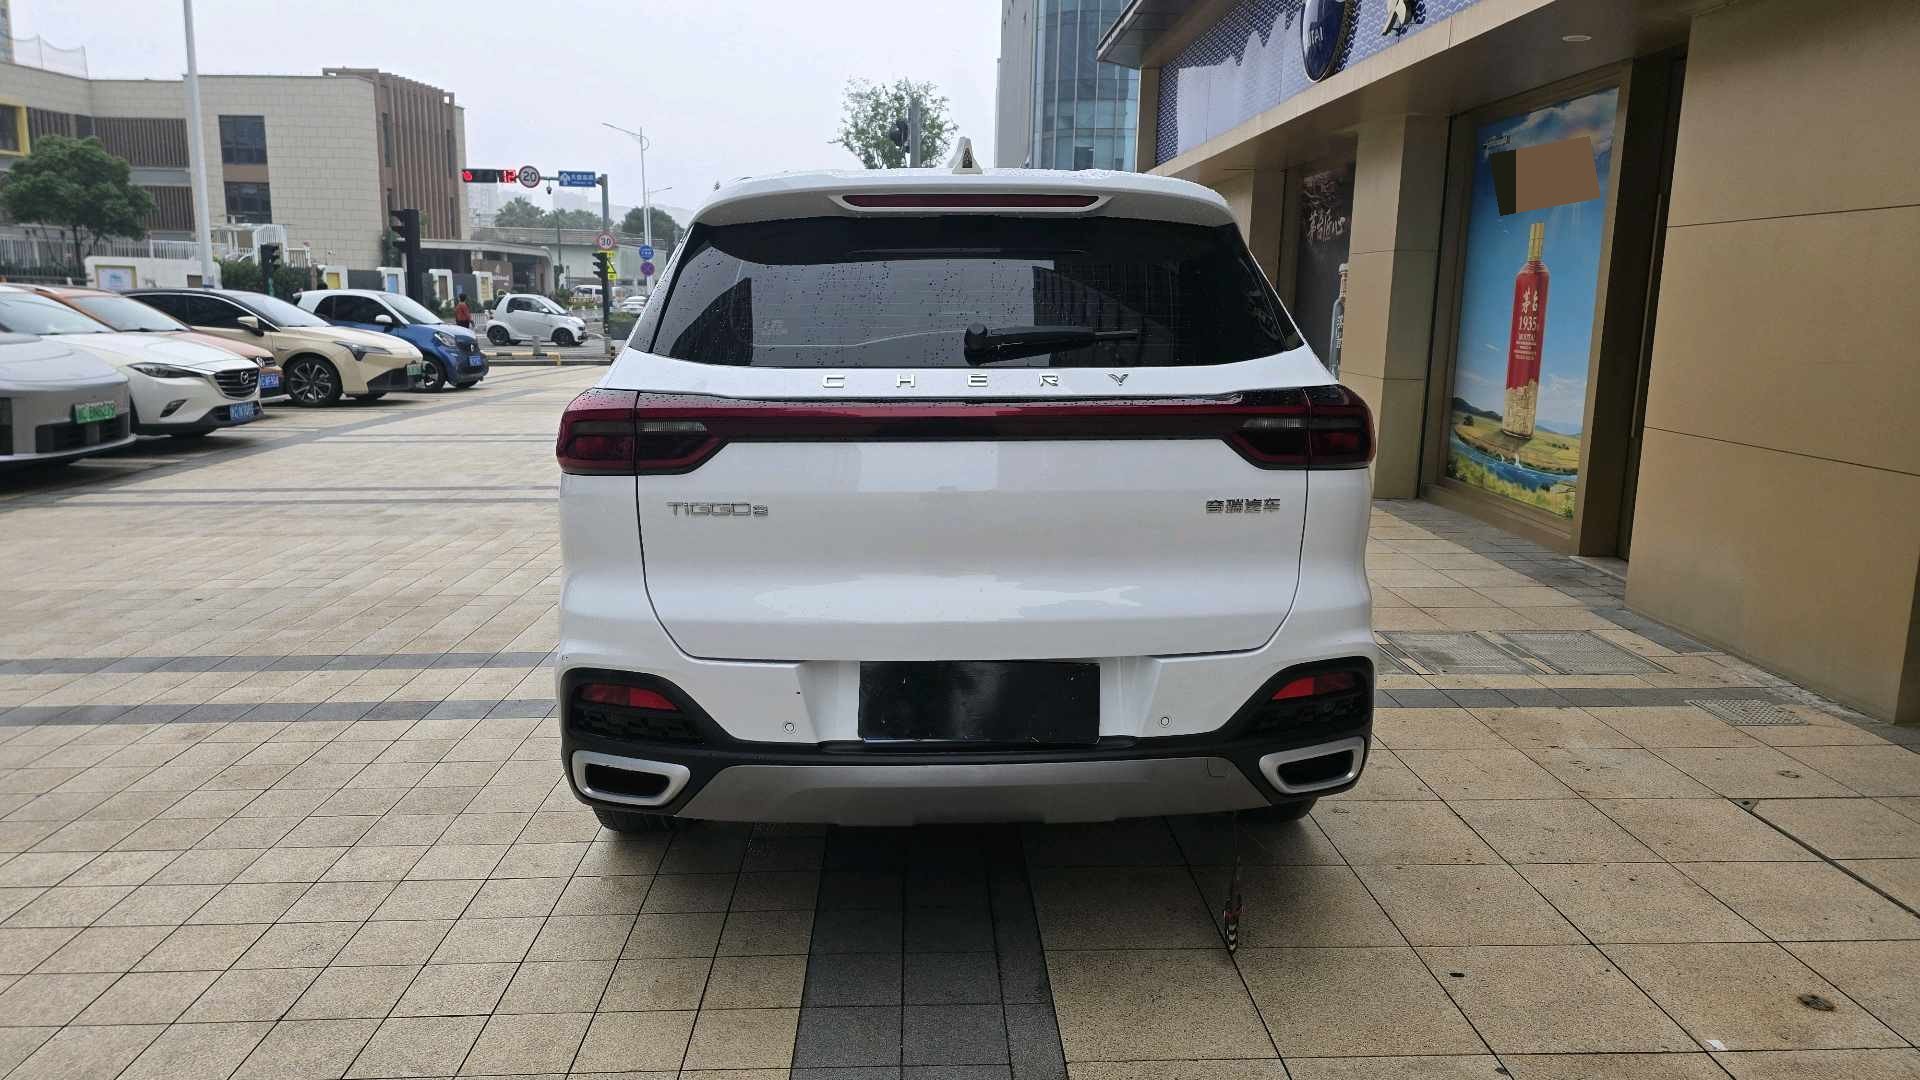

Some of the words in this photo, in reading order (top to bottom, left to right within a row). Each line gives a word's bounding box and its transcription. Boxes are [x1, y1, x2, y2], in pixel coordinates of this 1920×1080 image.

[523, 171, 537, 182] 20
[1518, 315, 1537, 331] 1935
[822, 373, 1129, 389] CHERY
[1206, 498, 1280, 514] 奇瑞汽车
